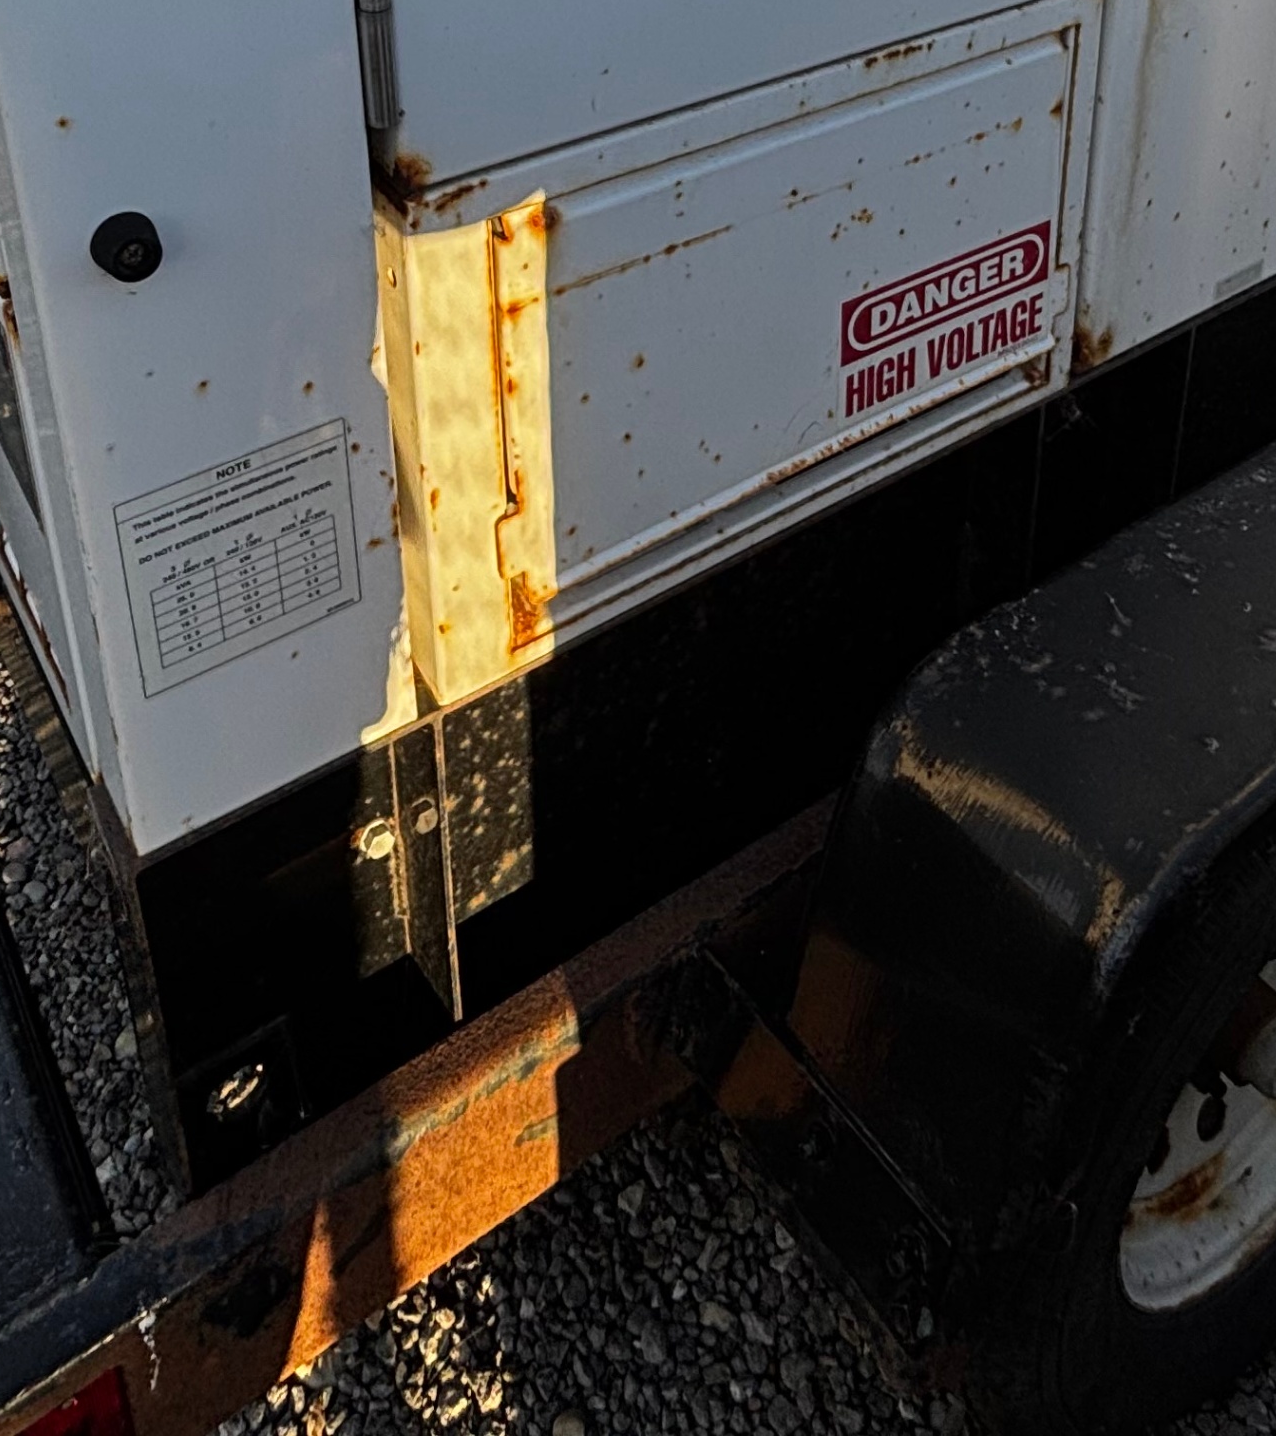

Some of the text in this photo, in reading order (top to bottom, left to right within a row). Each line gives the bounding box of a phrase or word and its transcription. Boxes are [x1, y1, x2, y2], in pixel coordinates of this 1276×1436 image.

[870, 247, 1025, 337] DANGER
[845, 291, 1044, 418] HIGH VOLTAGE
[132, 518, 151, 531] This
[153, 509, 174, 523] table
[175, 495, 213, 514] indicates
[214, 487, 228, 498] the
[229, 466, 283, 492] simultaneous
[284, 457, 308, 471] power
[215, 458, 251, 480] NOTE
[134, 535, 143, 544] at
[144, 523, 177, 539] various
[178, 510, 208, 527] voltage
[214, 497, 240, 512] phase
[138, 554, 152, 564] DO
[153, 546, 172, 558] NOT
[174, 532, 210, 549] EXCEED
[212, 514, 252, 534] MAXIMUM
[254, 495, 299, 516] AVAILABLE
